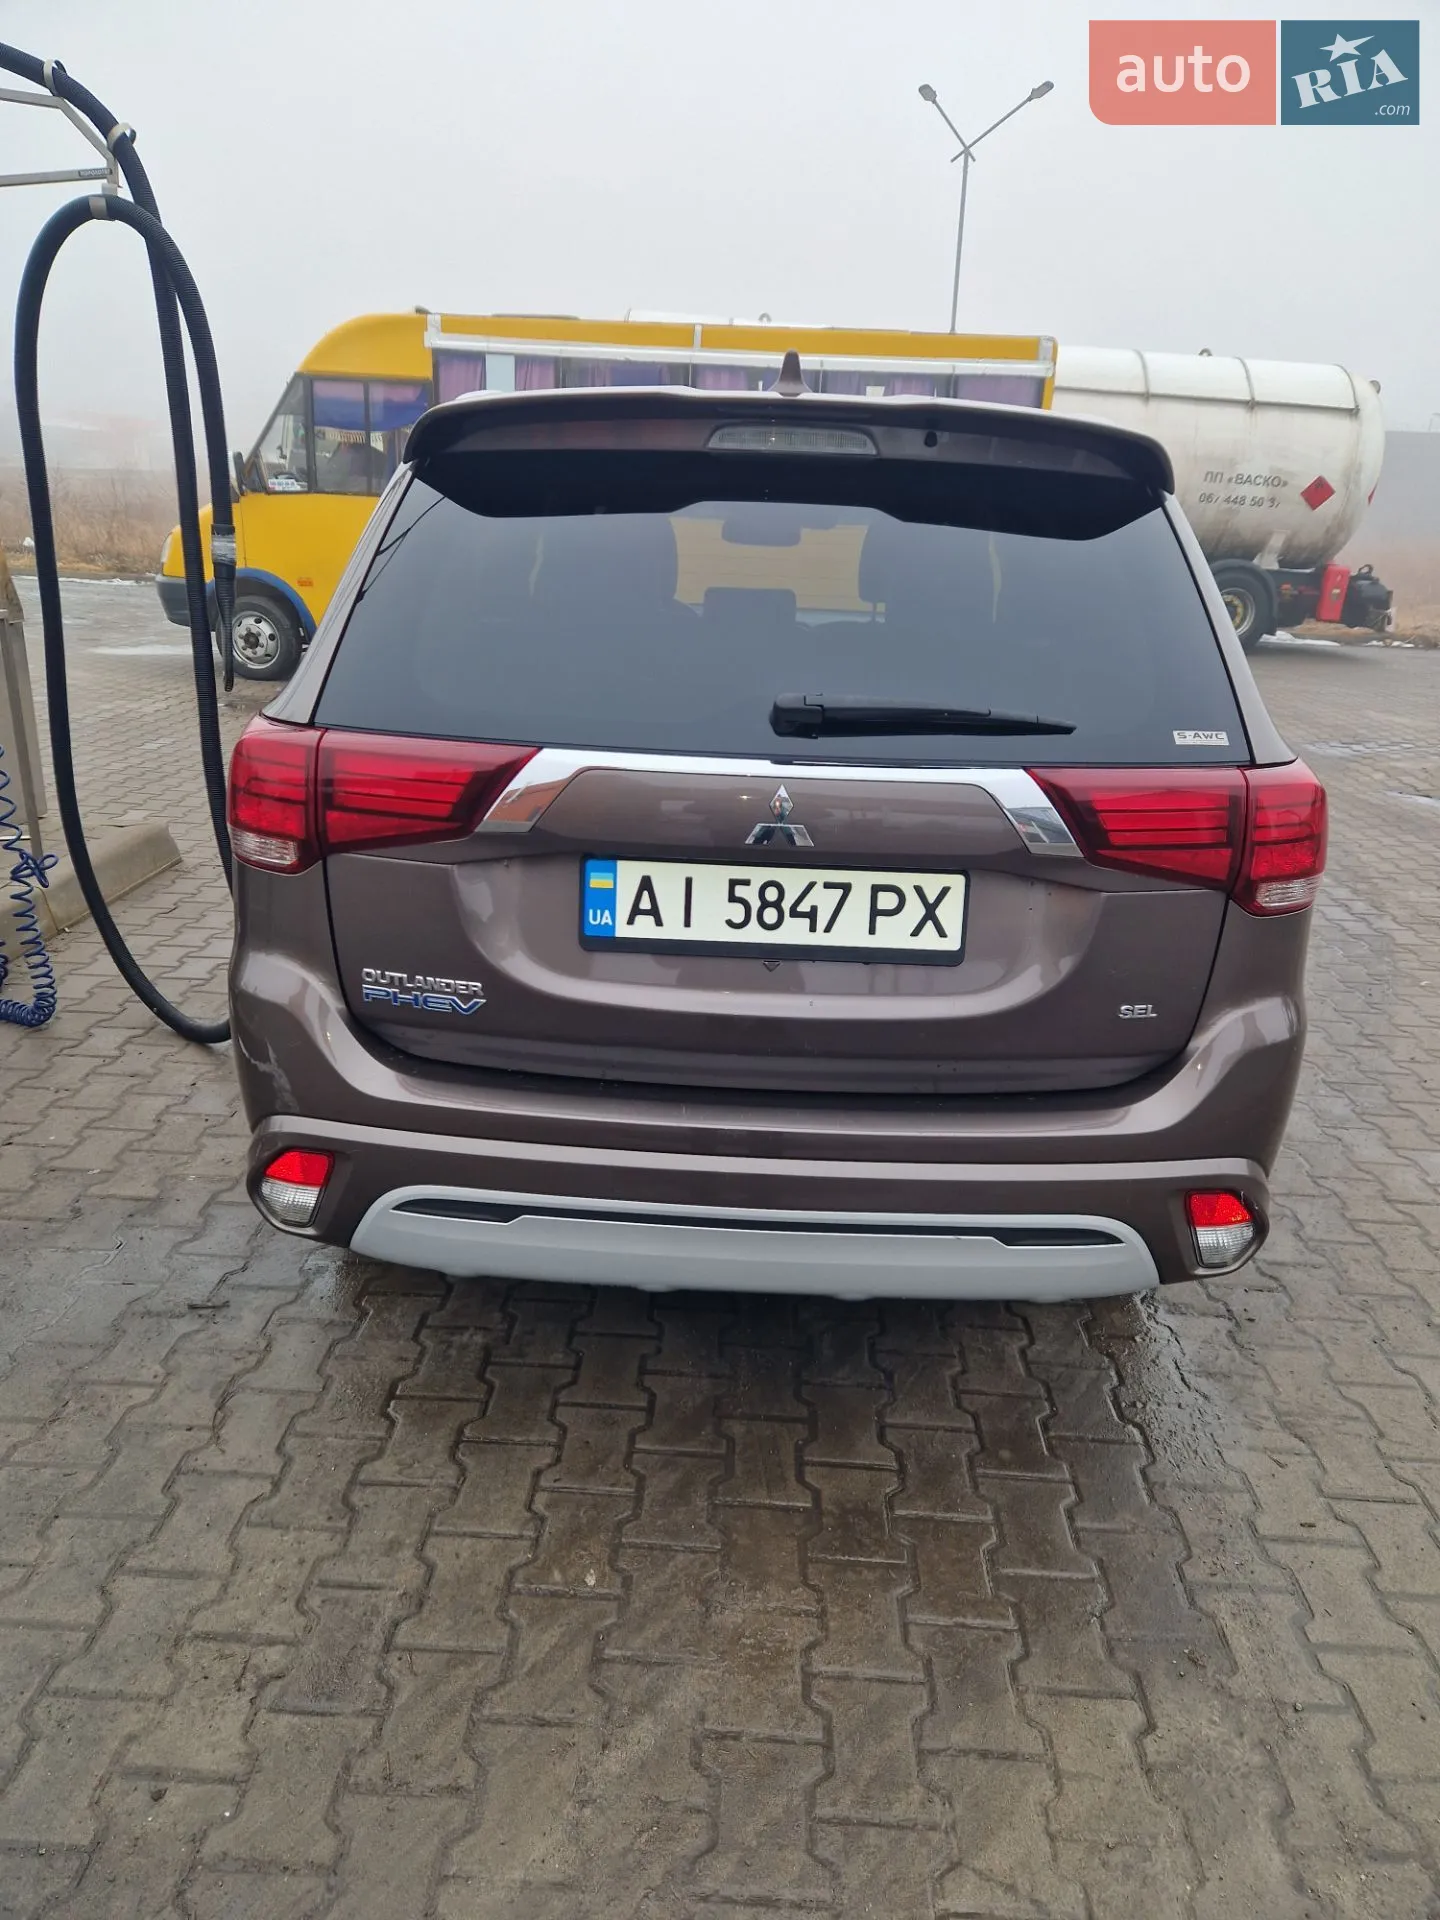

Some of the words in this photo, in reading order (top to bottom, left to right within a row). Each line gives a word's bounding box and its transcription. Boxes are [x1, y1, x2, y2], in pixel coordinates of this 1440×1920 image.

[1203, 470, 1224, 484] ПП
[1223, 494, 1247, 506] 448
[1249, 496, 1265, 507] 50
[1176, 732, 1225, 740] S-AWC
[626, 875, 693, 928] AI
[724, 878, 852, 934] 5847
[868, 884, 952, 938] PX
[589, 909, 613, 926] UA
[361, 967, 485, 996] OUTLANDER
[362, 984, 487, 1015] PHEV
[1118, 1004, 1158, 1019] SEL
